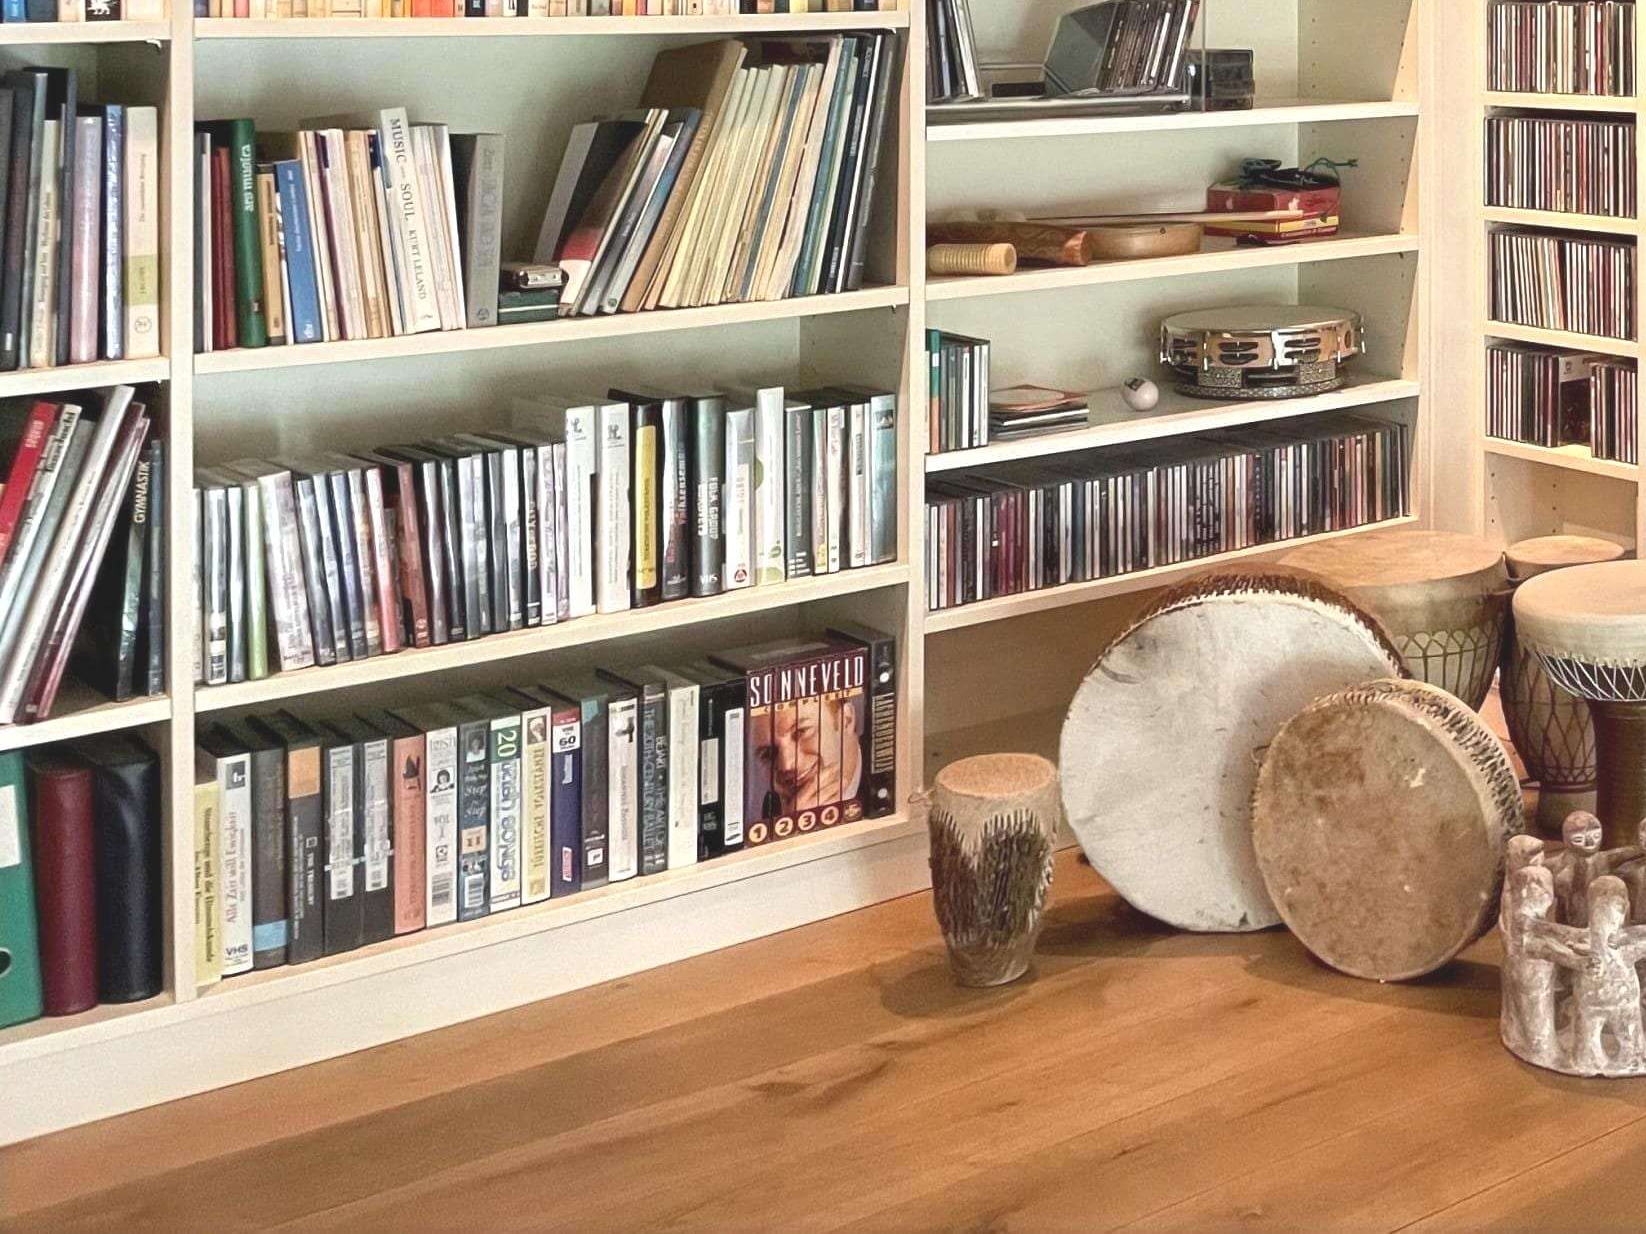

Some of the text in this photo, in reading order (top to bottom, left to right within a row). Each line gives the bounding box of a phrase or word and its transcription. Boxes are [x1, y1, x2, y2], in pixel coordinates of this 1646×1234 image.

[390, 118, 415, 221] MUSIC SOUL
[134, 460, 150, 523] GYMNASTIK
[750, 655, 865, 708] SONNEVELD
[497, 729, 517, 757] 20
[558, 735, 576, 747] 60
[226, 944, 248, 957] VHS
